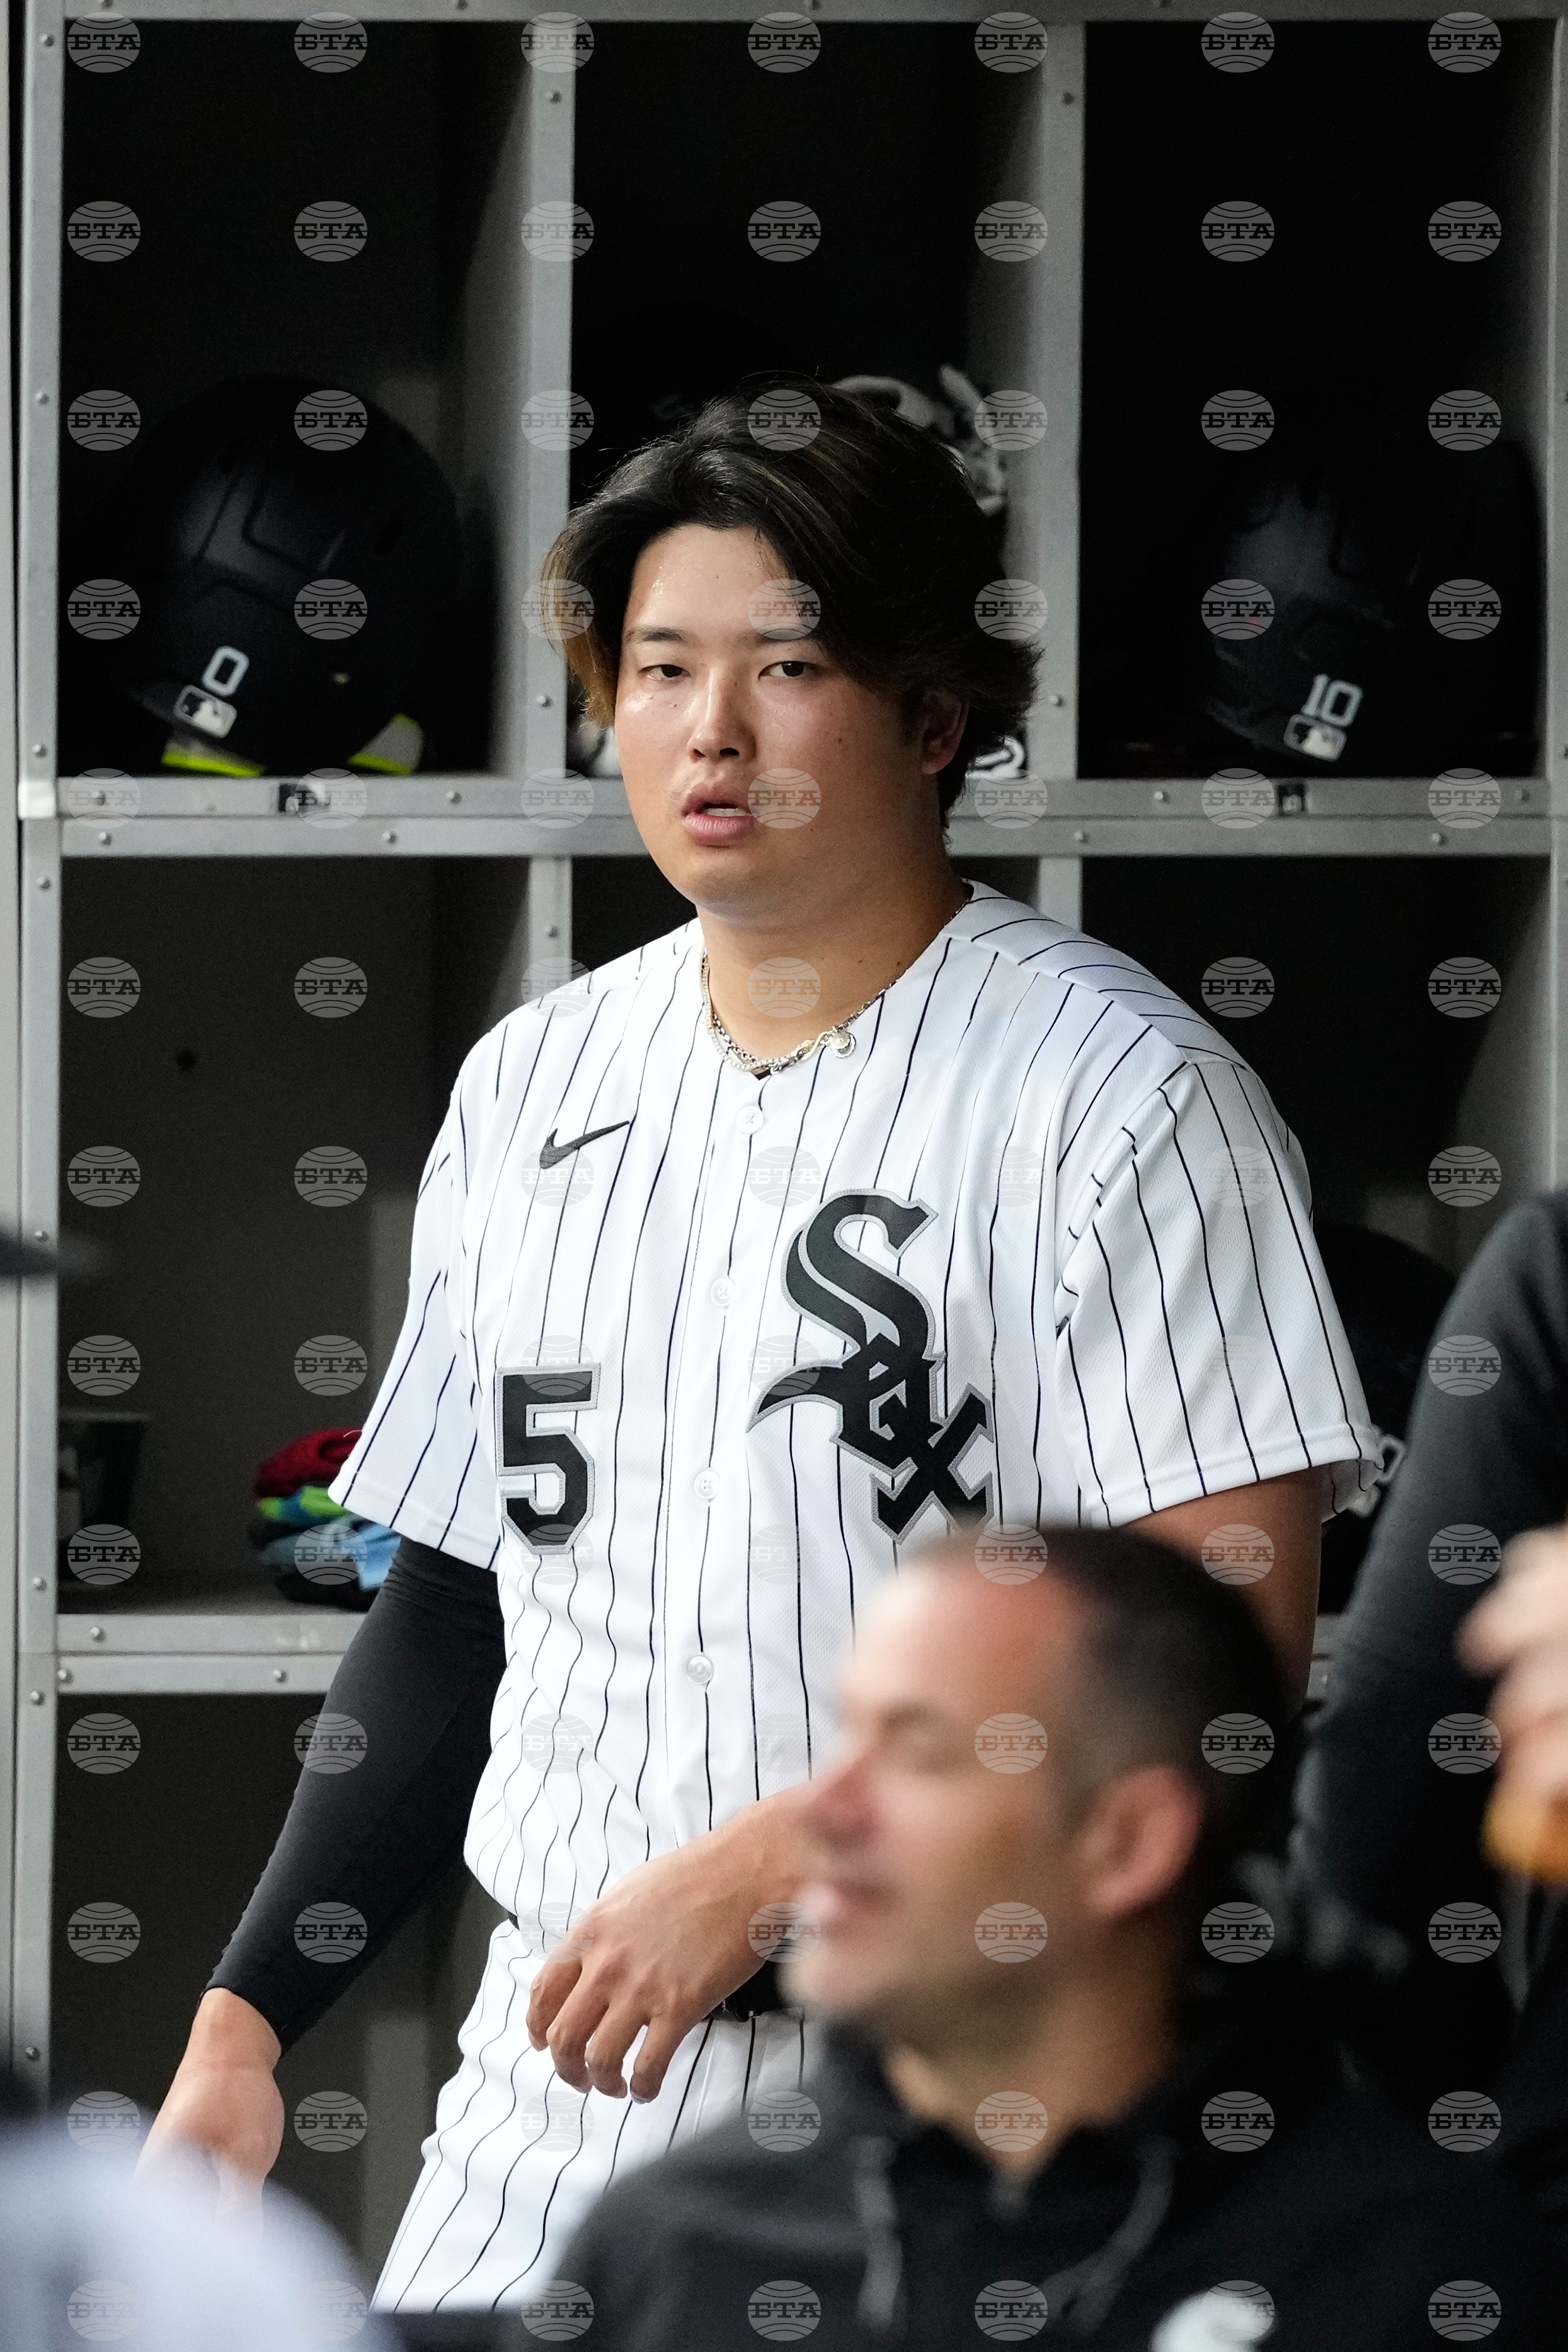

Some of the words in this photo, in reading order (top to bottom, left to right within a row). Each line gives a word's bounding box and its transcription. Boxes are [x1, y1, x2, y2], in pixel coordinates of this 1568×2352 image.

[201, 645, 249, 697] 0
[1301, 674, 1363, 727] 10
[496, 1363, 600, 1555] 5
